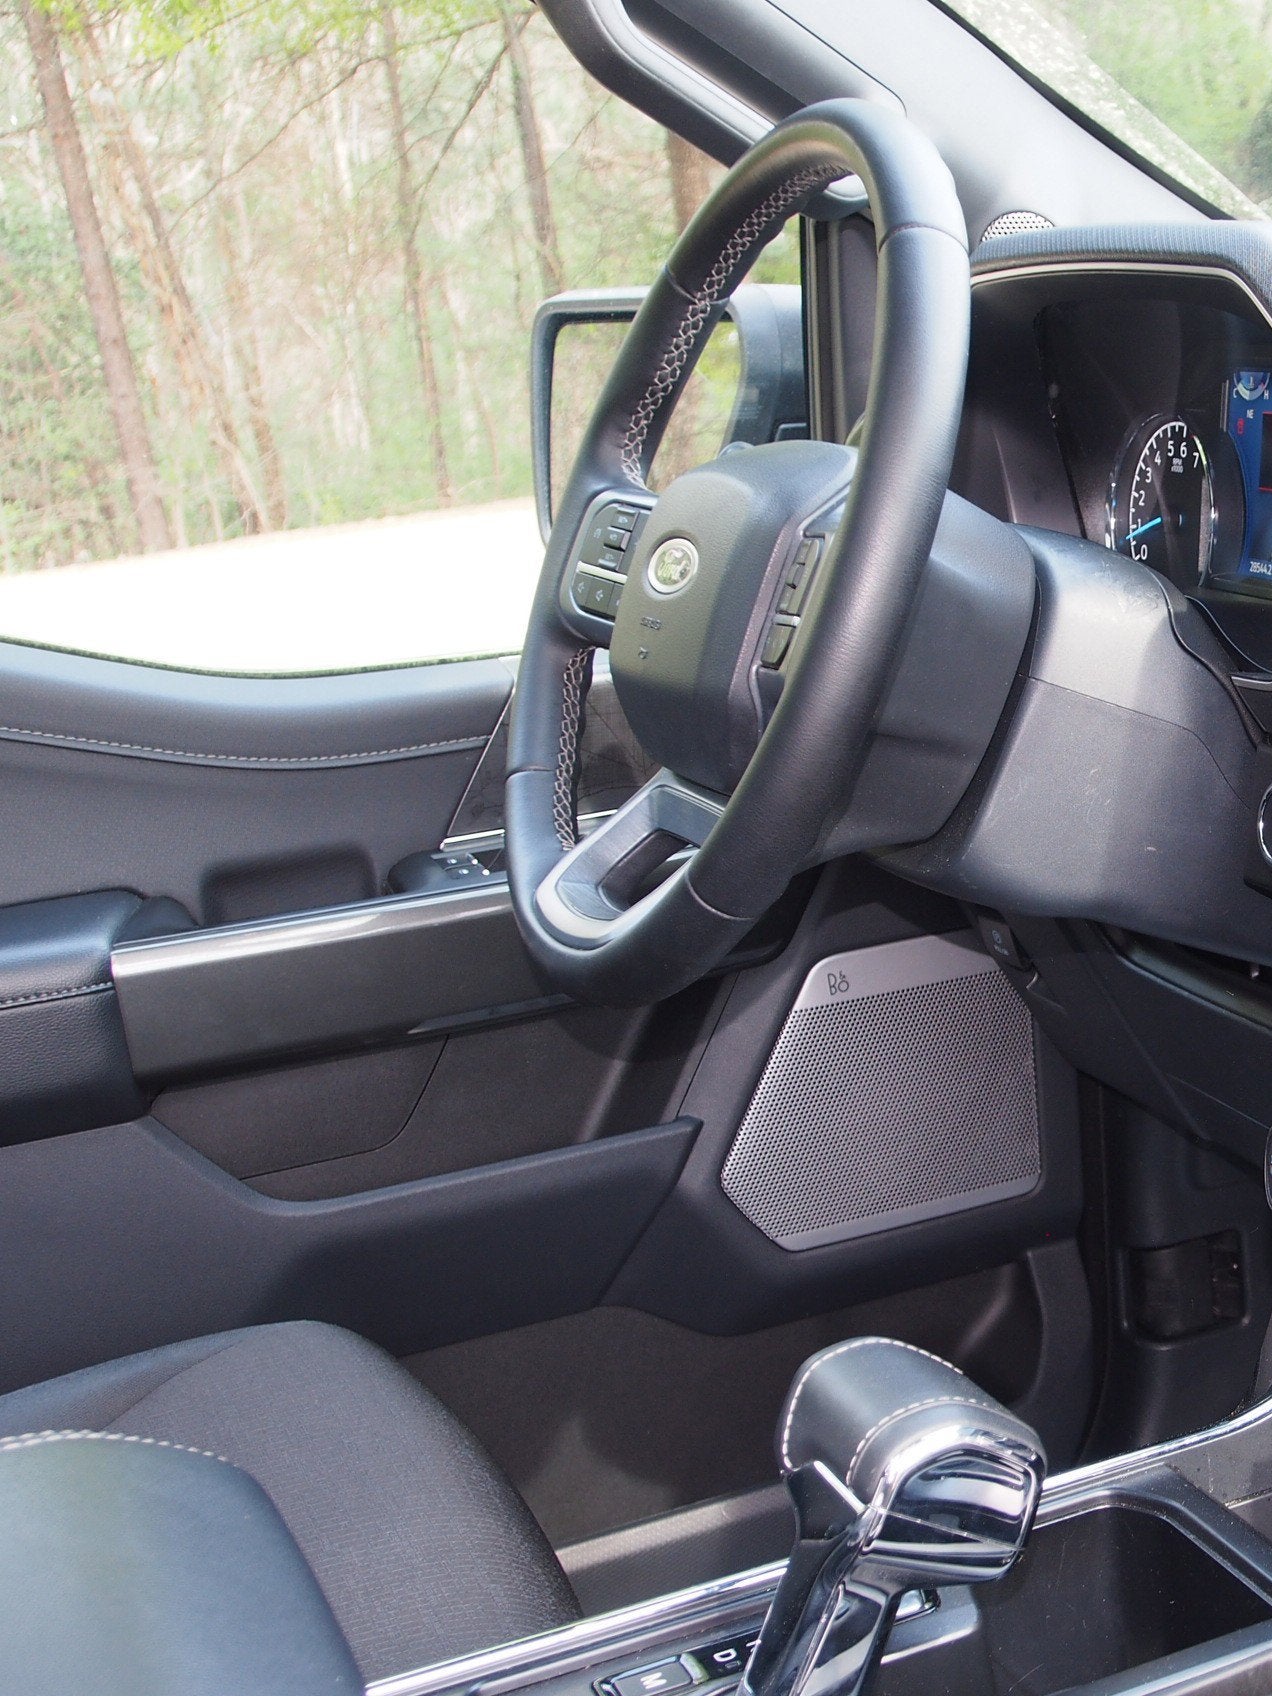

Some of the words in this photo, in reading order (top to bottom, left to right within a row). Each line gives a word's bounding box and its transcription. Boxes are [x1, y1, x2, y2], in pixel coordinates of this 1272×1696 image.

[1264, 390, 1269, 400] H
[1167, 441, 1174, 457] 5
[1180, 442, 1187, 458] 6
[1154, 450, 1161, 466] 4
[1193, 452, 1199, 468] 7
[1145, 467, 1152, 483] 3
[1138, 490, 1145, 506] 2
[1140, 544, 1148, 560] 0
[713, 1647, 737, 1663] D
